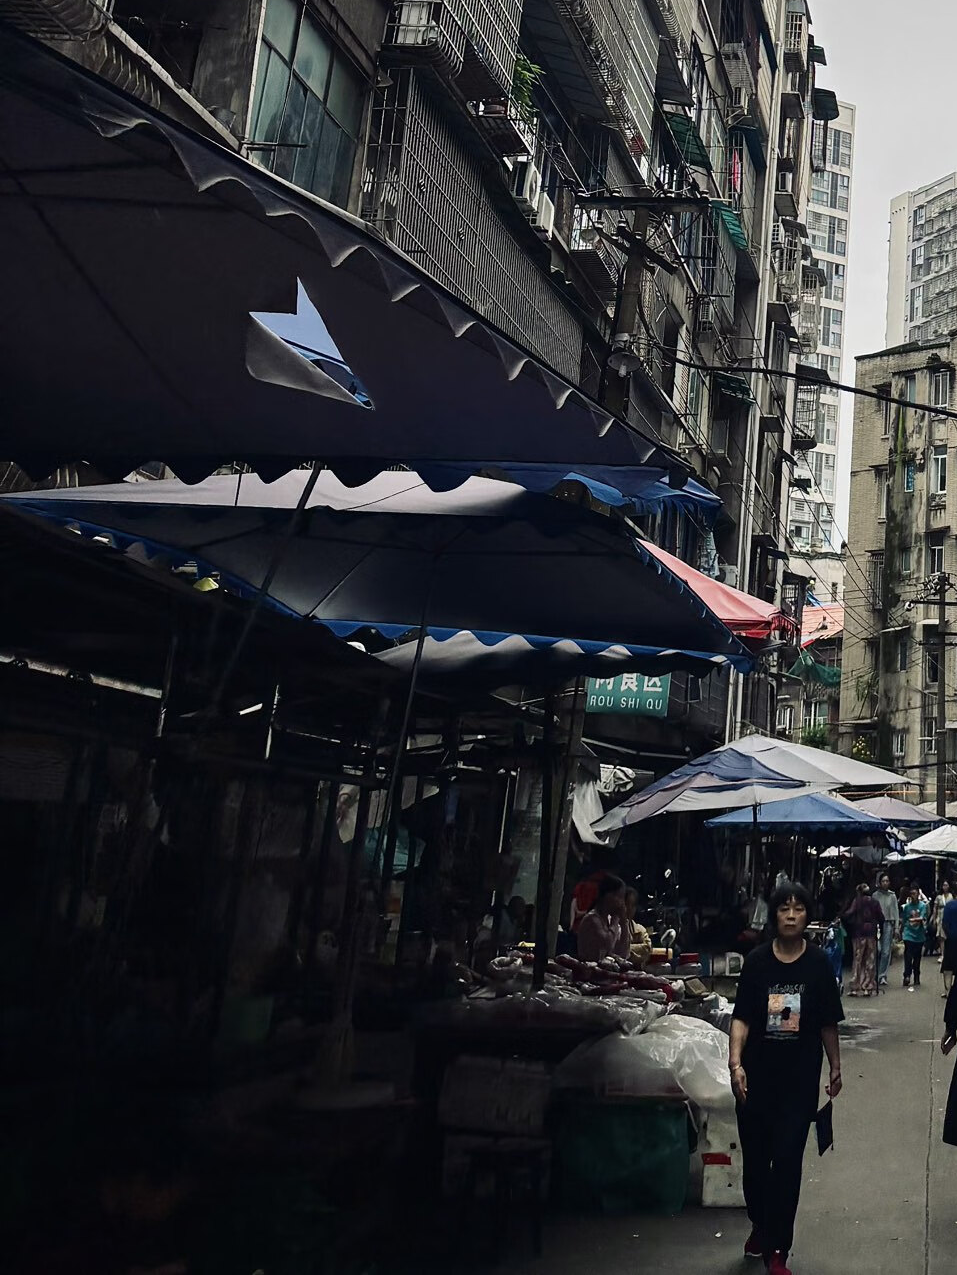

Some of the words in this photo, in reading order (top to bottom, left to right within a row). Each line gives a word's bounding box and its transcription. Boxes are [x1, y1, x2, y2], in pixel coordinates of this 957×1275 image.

[590, 695, 614, 707] ROU
[620, 697, 640, 709] SHI
[646, 698, 663, 710] QU
